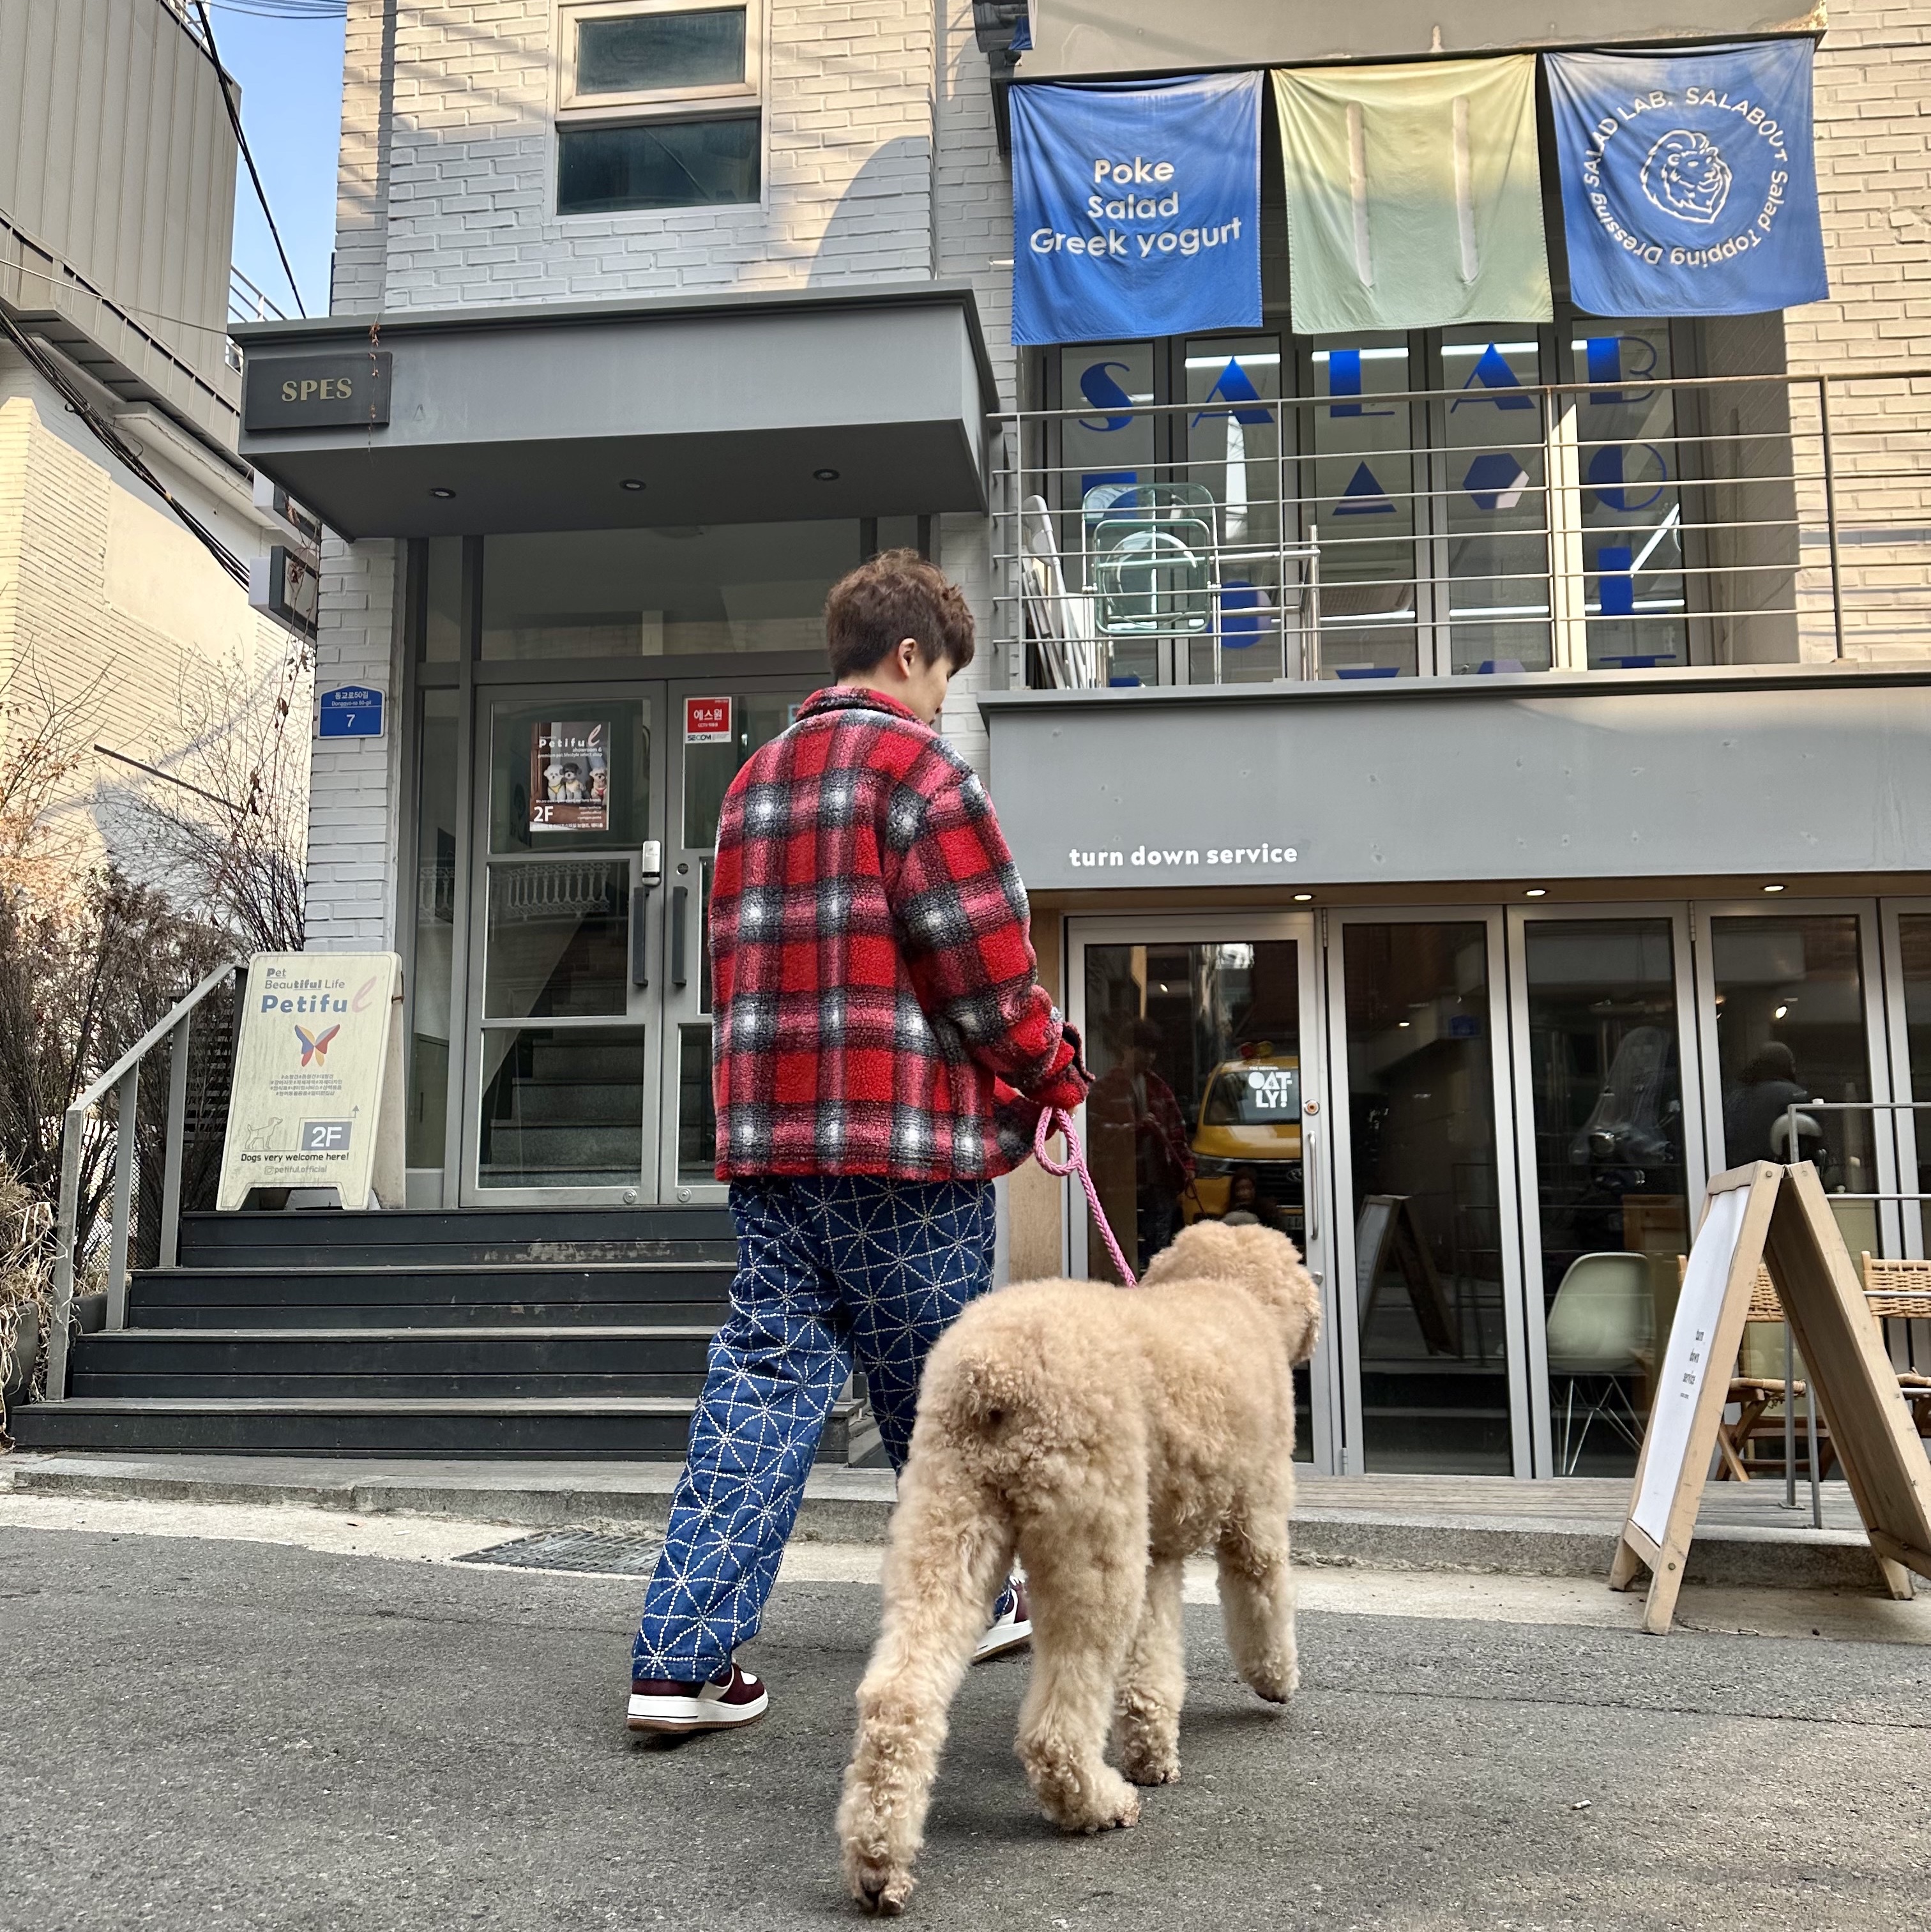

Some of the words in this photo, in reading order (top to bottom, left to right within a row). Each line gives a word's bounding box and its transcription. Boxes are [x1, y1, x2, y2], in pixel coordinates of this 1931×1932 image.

[1685, 87, 1788, 162] SALABOUT
[1584, 118, 1619, 186] SALAD
[1617, 90, 1673, 120] LAB.
[1094, 156, 1174, 183] Poke
[1087, 192, 1179, 219] Salad
[1757, 171, 1788, 231] Salad
[1030, 228, 1128, 255] Greek
[1137, 217, 1241, 258] yogurt
[1590, 192, 1663, 264] Dressing
[1670, 229, 1762, 268] Topping
[281, 378, 352, 402] SPES
[346, 714, 356, 728] 7
[693, 708, 722, 720] 에스원
[539, 724, 602, 748] Petiful
[534, 805, 554, 822] 2F
[1069, 849, 1124, 866] turn
[1131, 845, 1199, 865] down
[1206, 842, 1298, 863] service
[265, 979, 322, 989] Beautiful
[324, 979, 345, 989] Life
[266, 968, 287, 977] Pet
[261, 976, 377, 1013] Petiful
[1256, 1090, 1287, 1108] LY!
[311, 1126, 342, 1147] 2F
[241, 1153, 262, 1163] Dogs
[264, 1154, 284, 1162] very
[285, 1153, 324, 1161] welcome
[326, 1152, 349, 1161] here!
